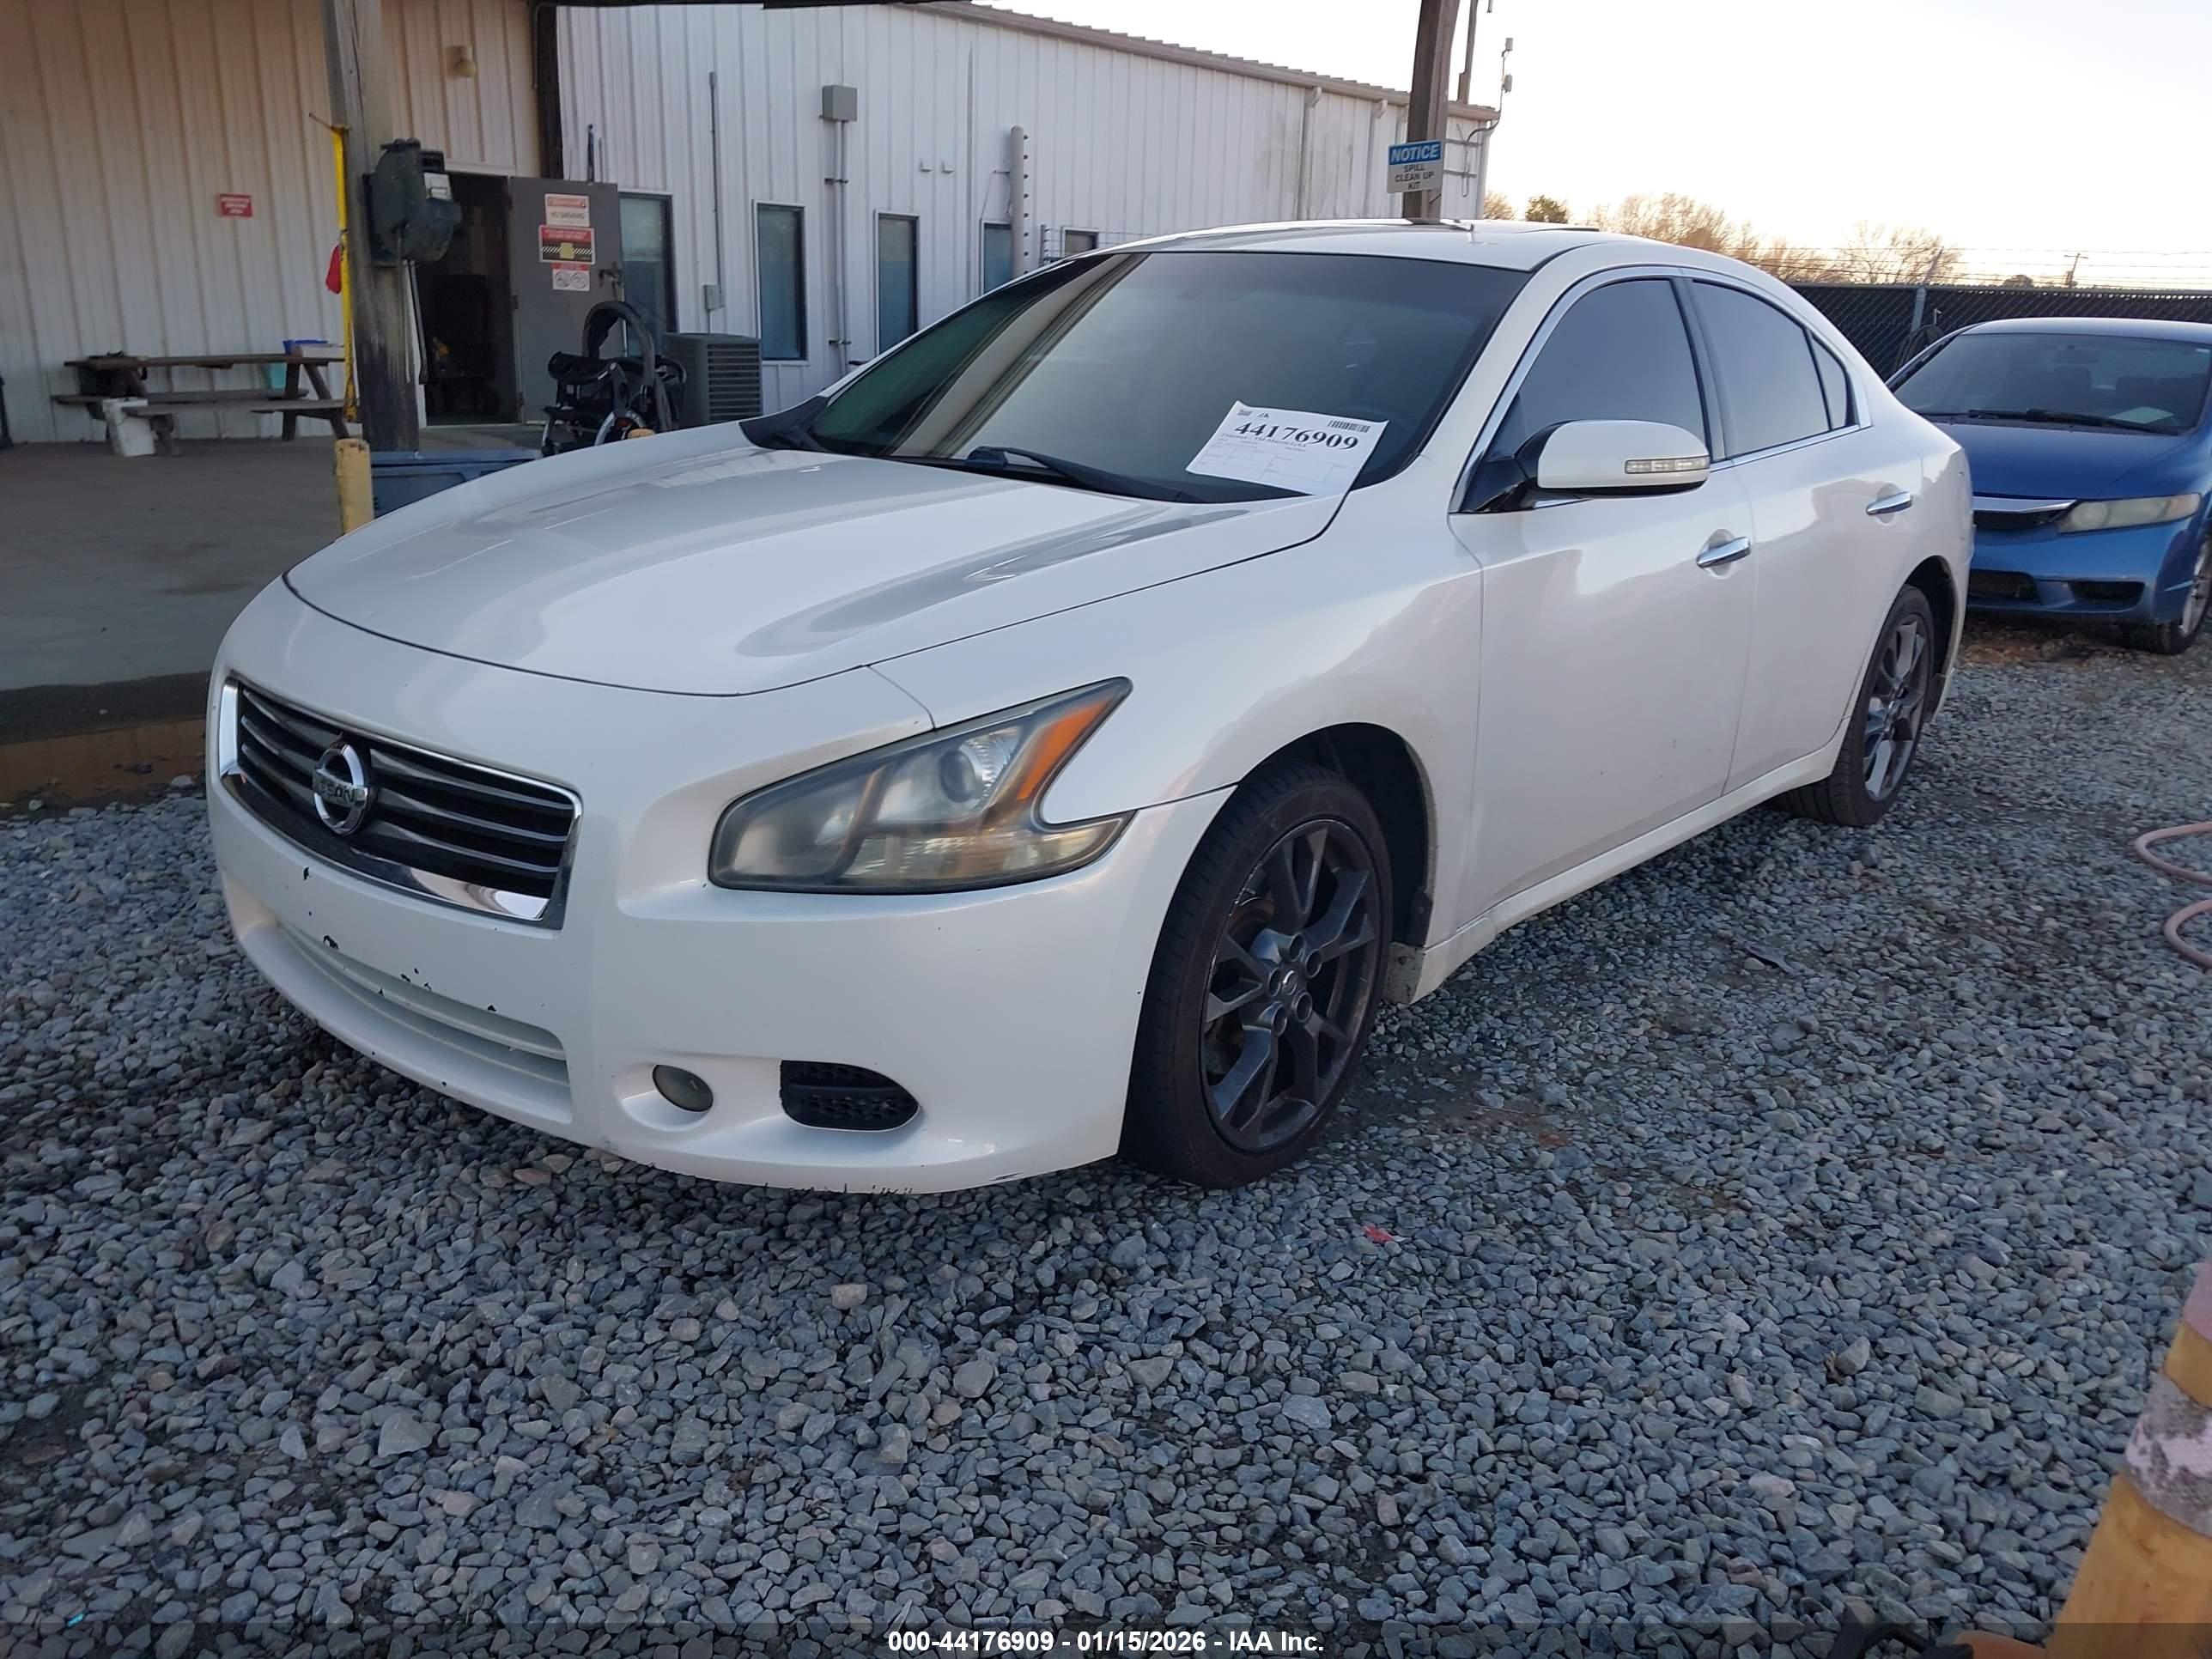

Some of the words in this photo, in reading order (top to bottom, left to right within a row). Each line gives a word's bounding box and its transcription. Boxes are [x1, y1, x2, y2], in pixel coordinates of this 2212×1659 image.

[1391, 143, 1440, 162] NOTICE
[1395, 173, 1420, 182] CLEAN
[1423, 171, 1434, 179] UP
[1234, 422, 1358, 450] 44176909
